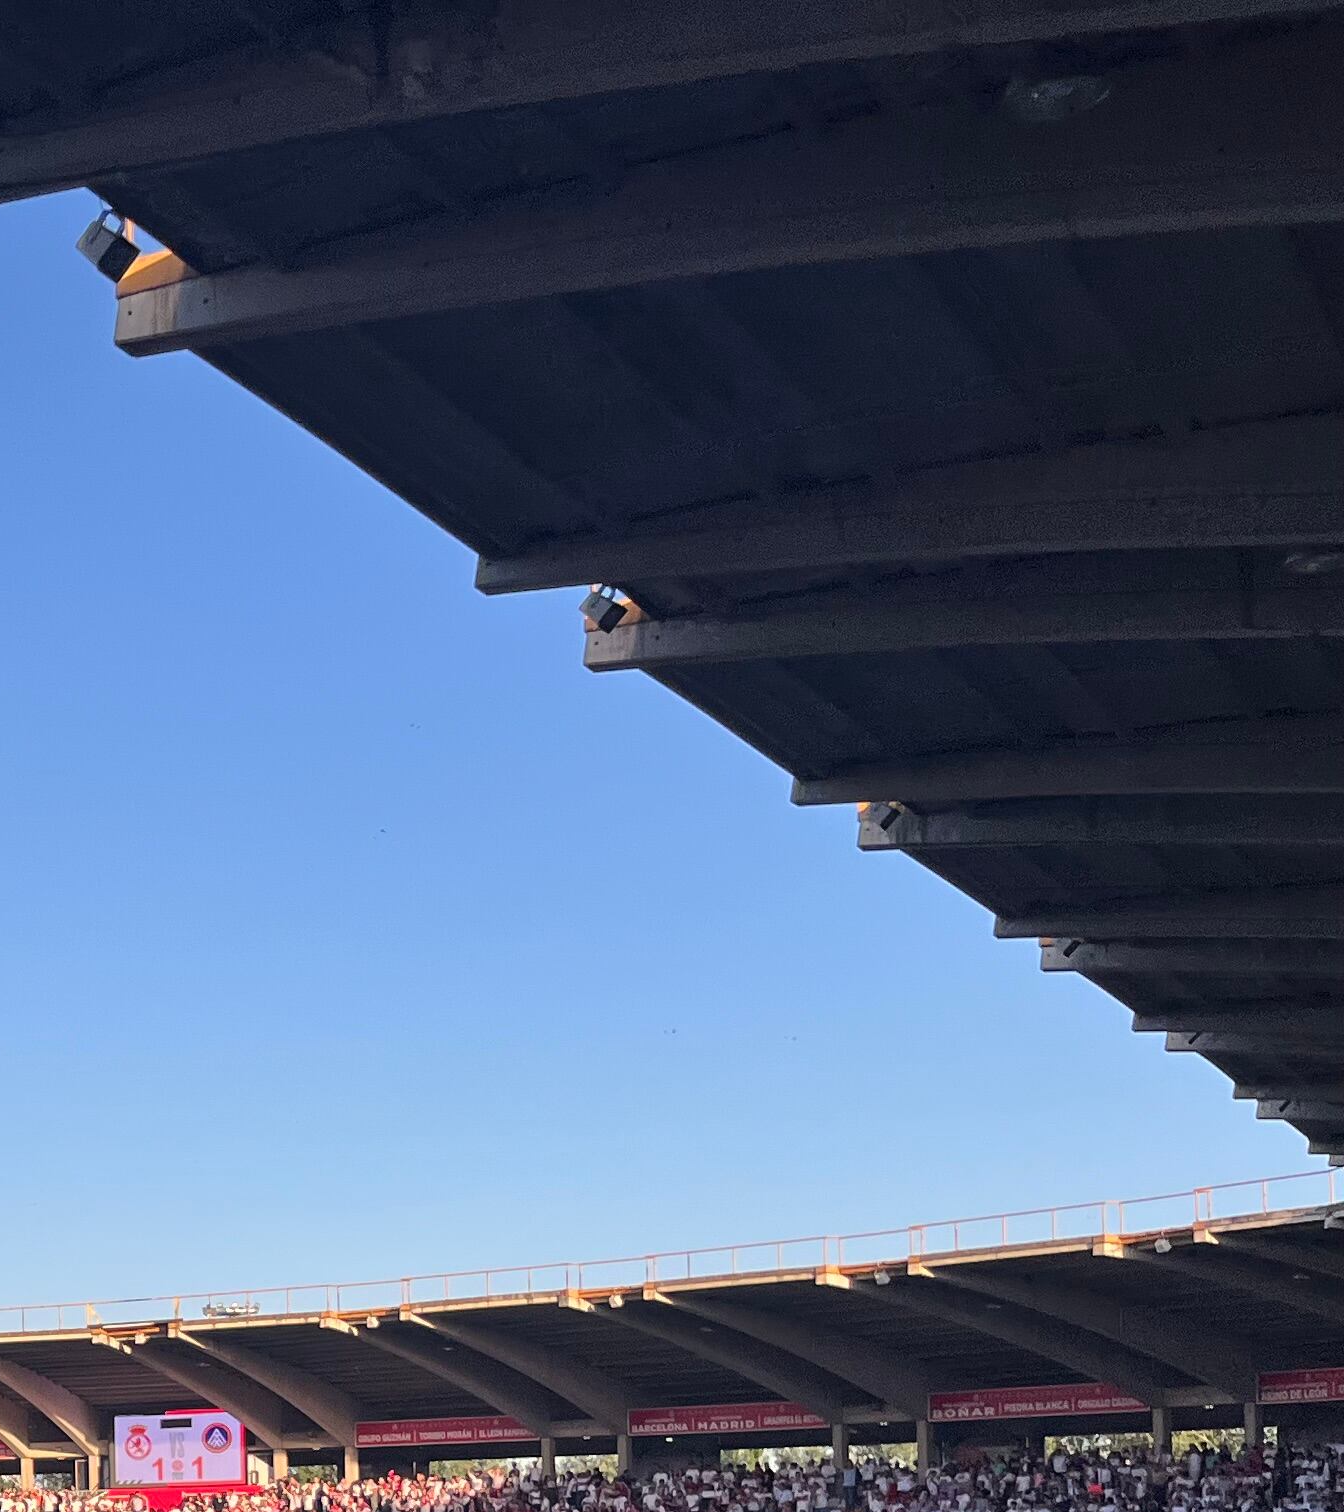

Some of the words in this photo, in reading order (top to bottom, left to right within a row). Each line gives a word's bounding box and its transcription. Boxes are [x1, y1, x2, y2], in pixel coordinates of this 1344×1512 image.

[631, 1422, 689, 1433] BARCELONA
[697, 1419, 755, 1431] MADRID
[152, 1457, 164, 1481] 1
[192, 1456, 203, 1480] 1
